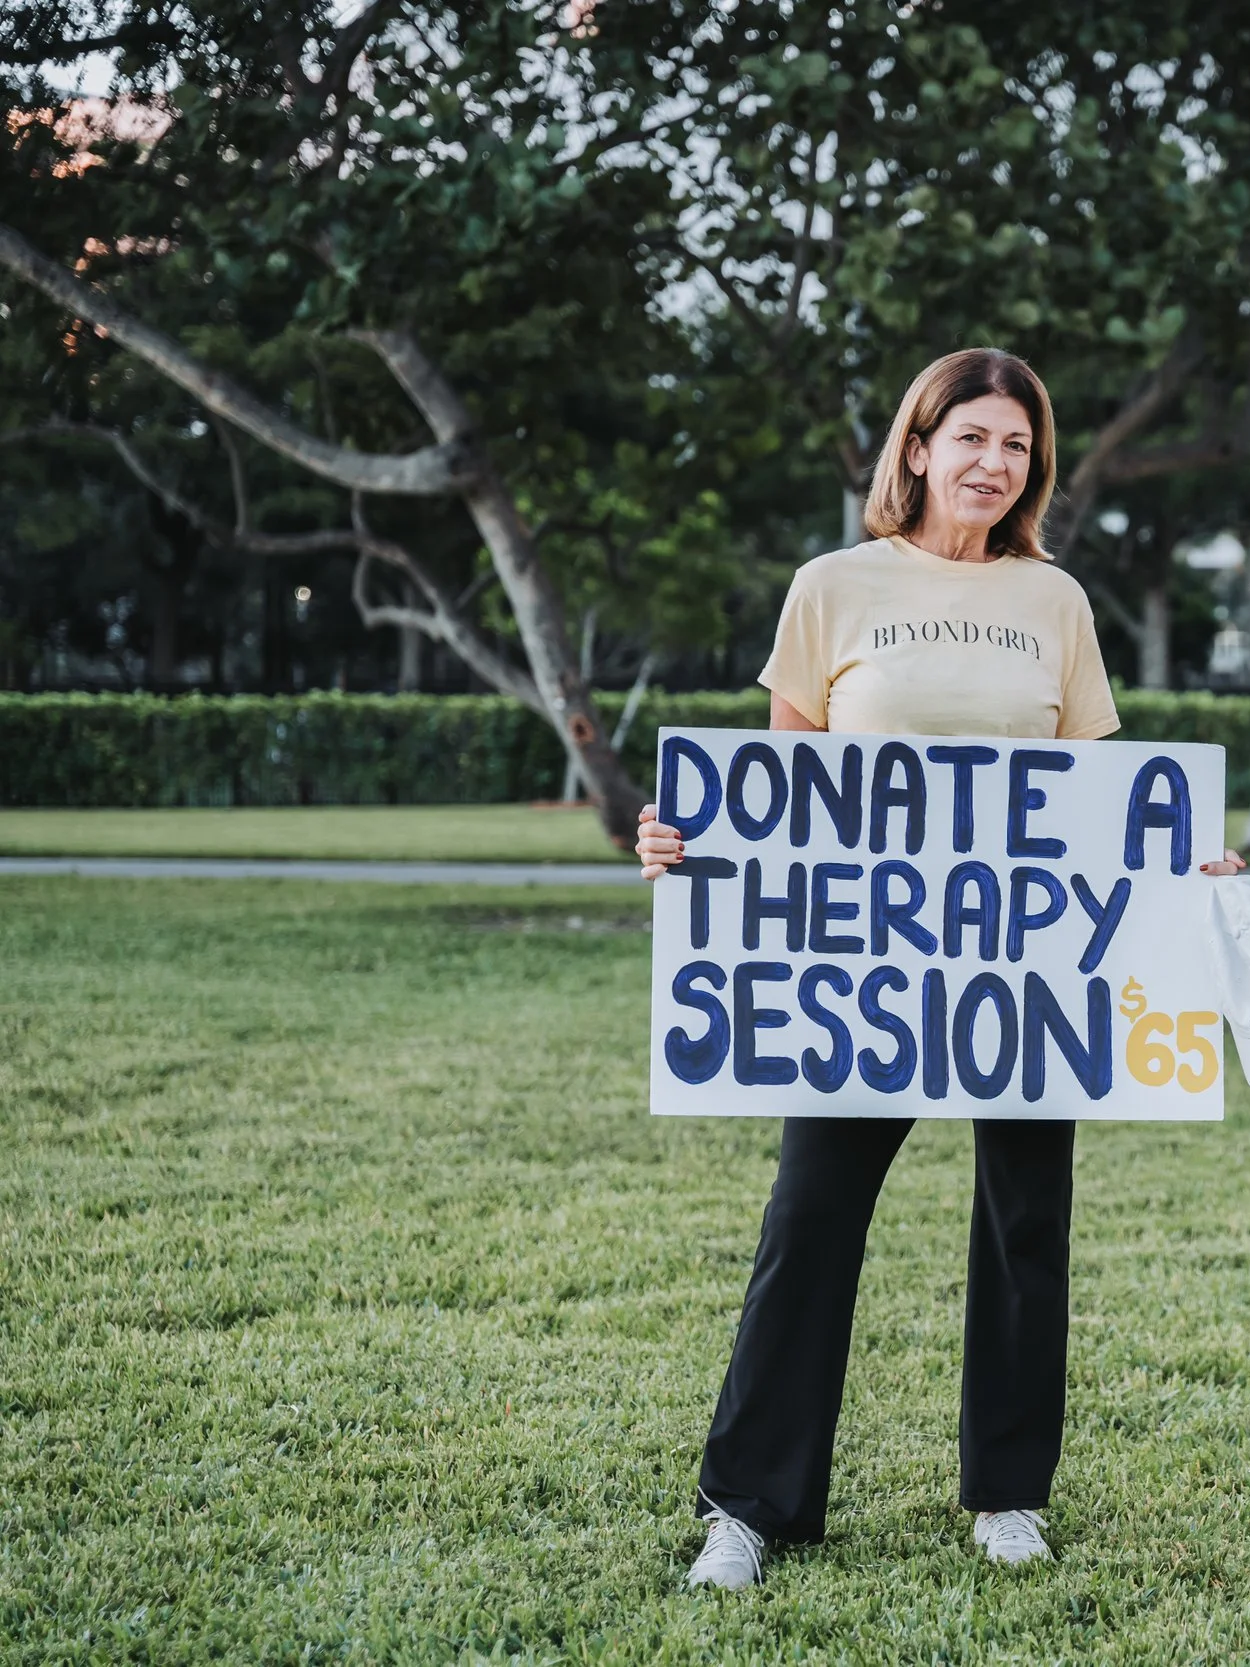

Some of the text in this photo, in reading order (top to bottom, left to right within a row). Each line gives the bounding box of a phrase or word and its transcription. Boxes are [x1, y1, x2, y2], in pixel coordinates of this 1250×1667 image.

[873, 620, 1042, 660] BEYOND GREY
[659, 735, 1192, 876] DONATE A
[666, 856, 1132, 975] THERAPY
[664, 960, 1219, 1103] SESSION $65
